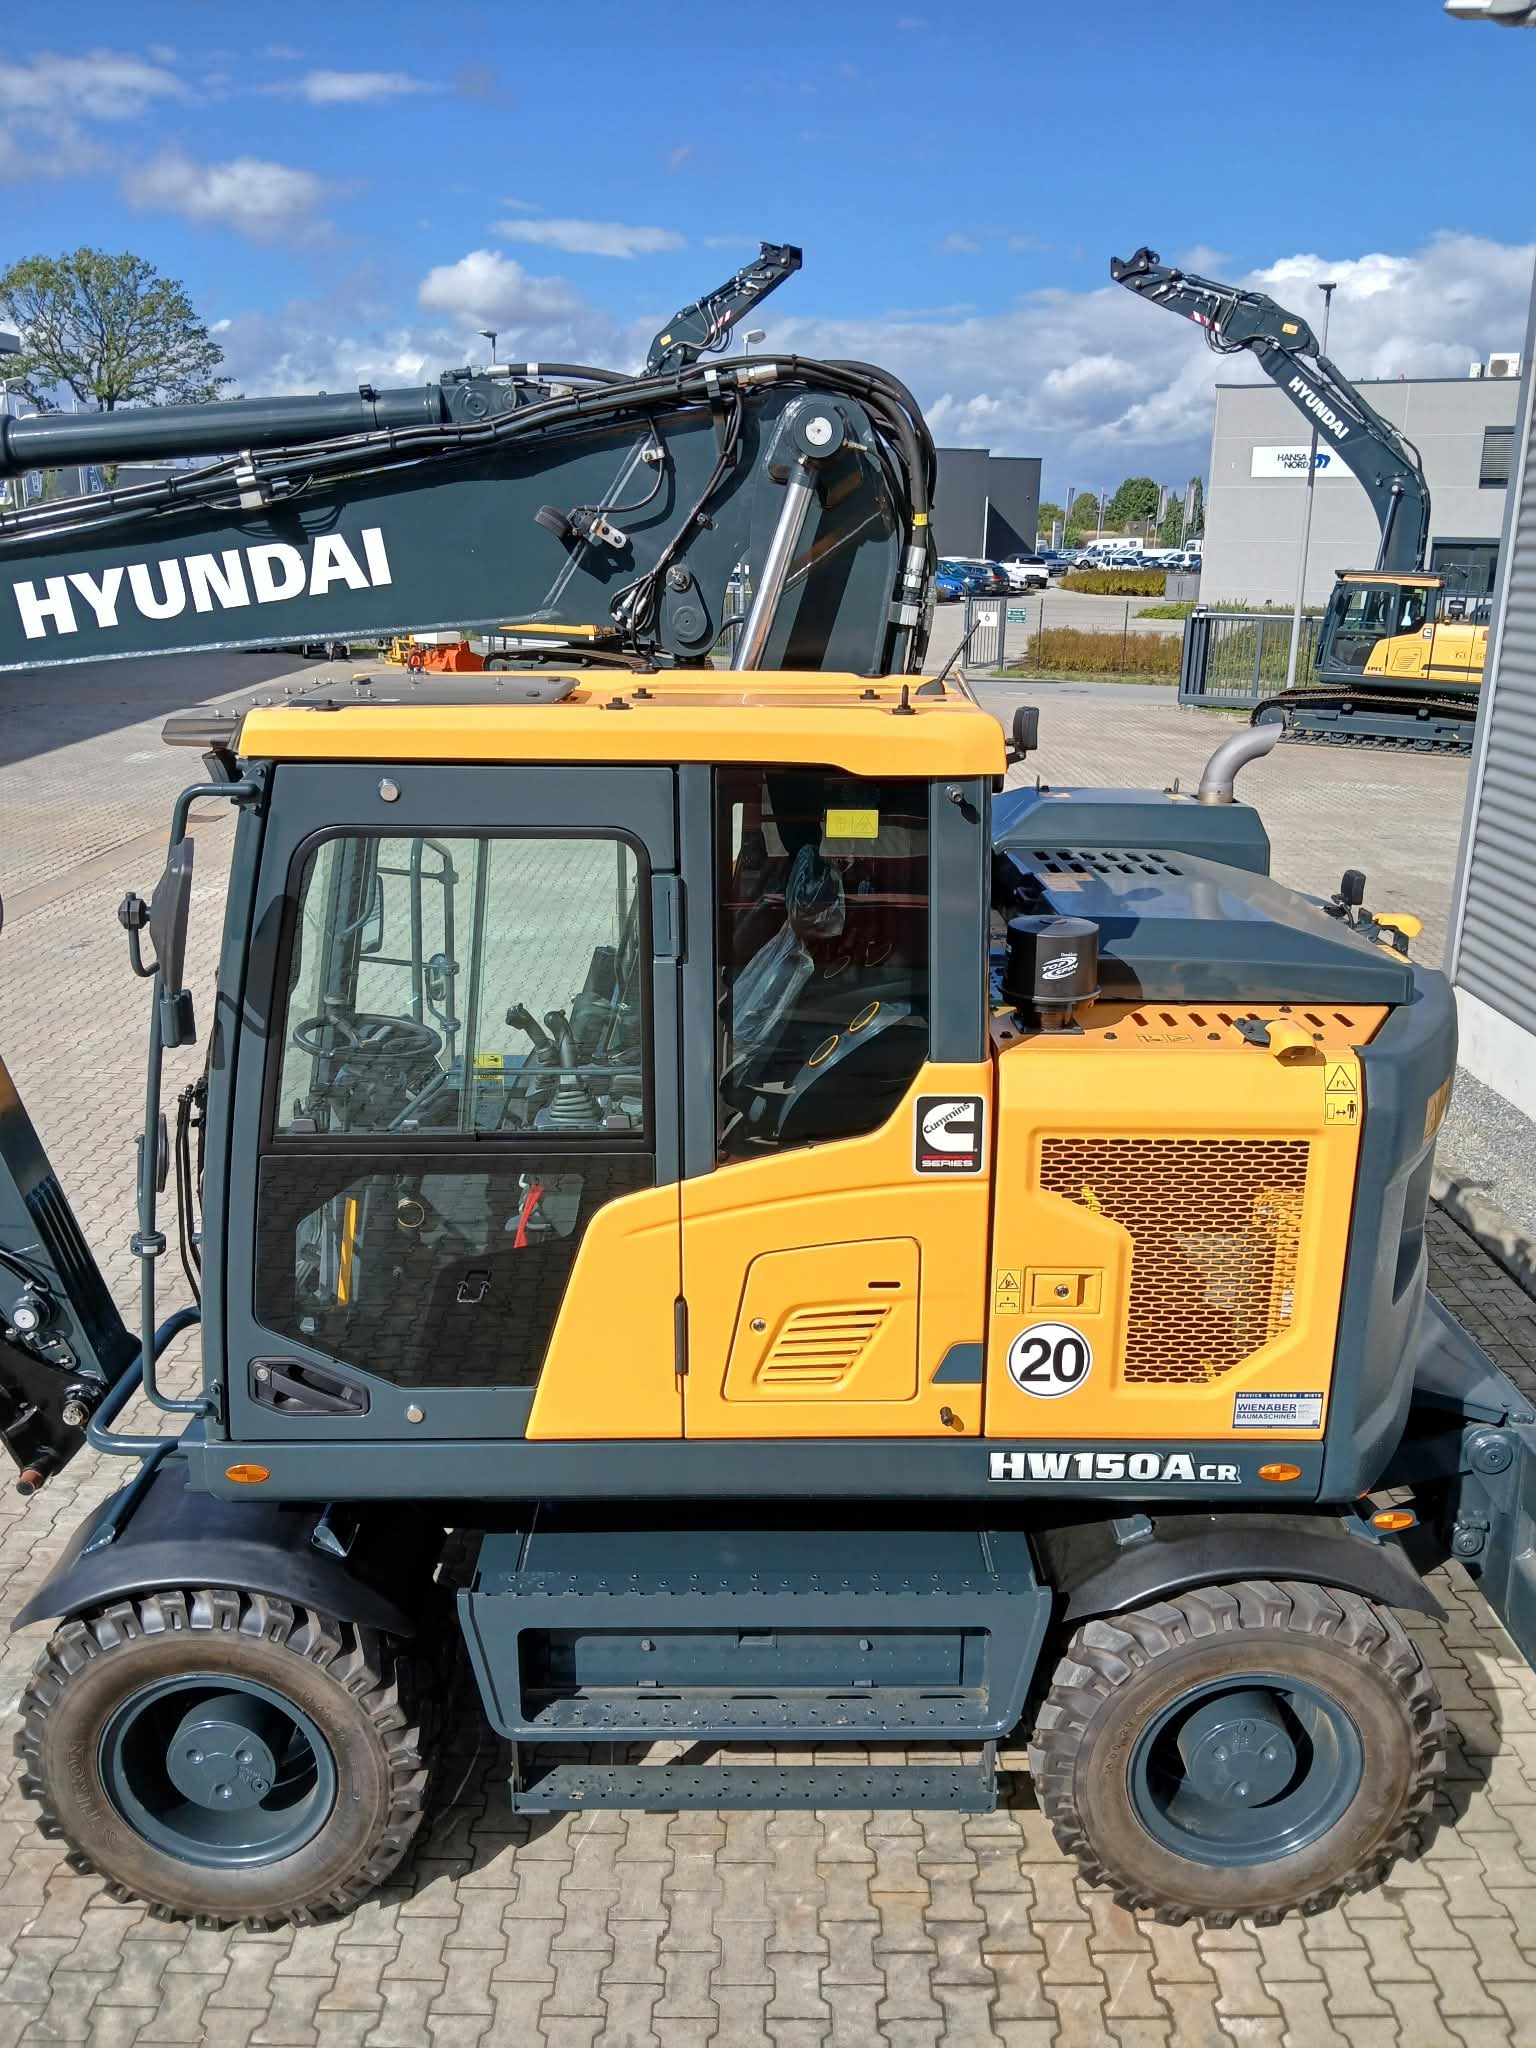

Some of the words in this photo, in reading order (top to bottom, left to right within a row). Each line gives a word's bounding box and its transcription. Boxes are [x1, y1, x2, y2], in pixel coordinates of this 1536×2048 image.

[1288, 376, 1349, 439] HYUNDAI
[12, 527, 392, 639] HYUNDAI
[1042, 961, 1069, 971] TOP
[1055, 962, 1079, 976] SPIN
[923, 1102, 970, 1134] Cummins
[921, 1160, 973, 1168] SERIES
[1019, 1338, 1085, 1382] 20
